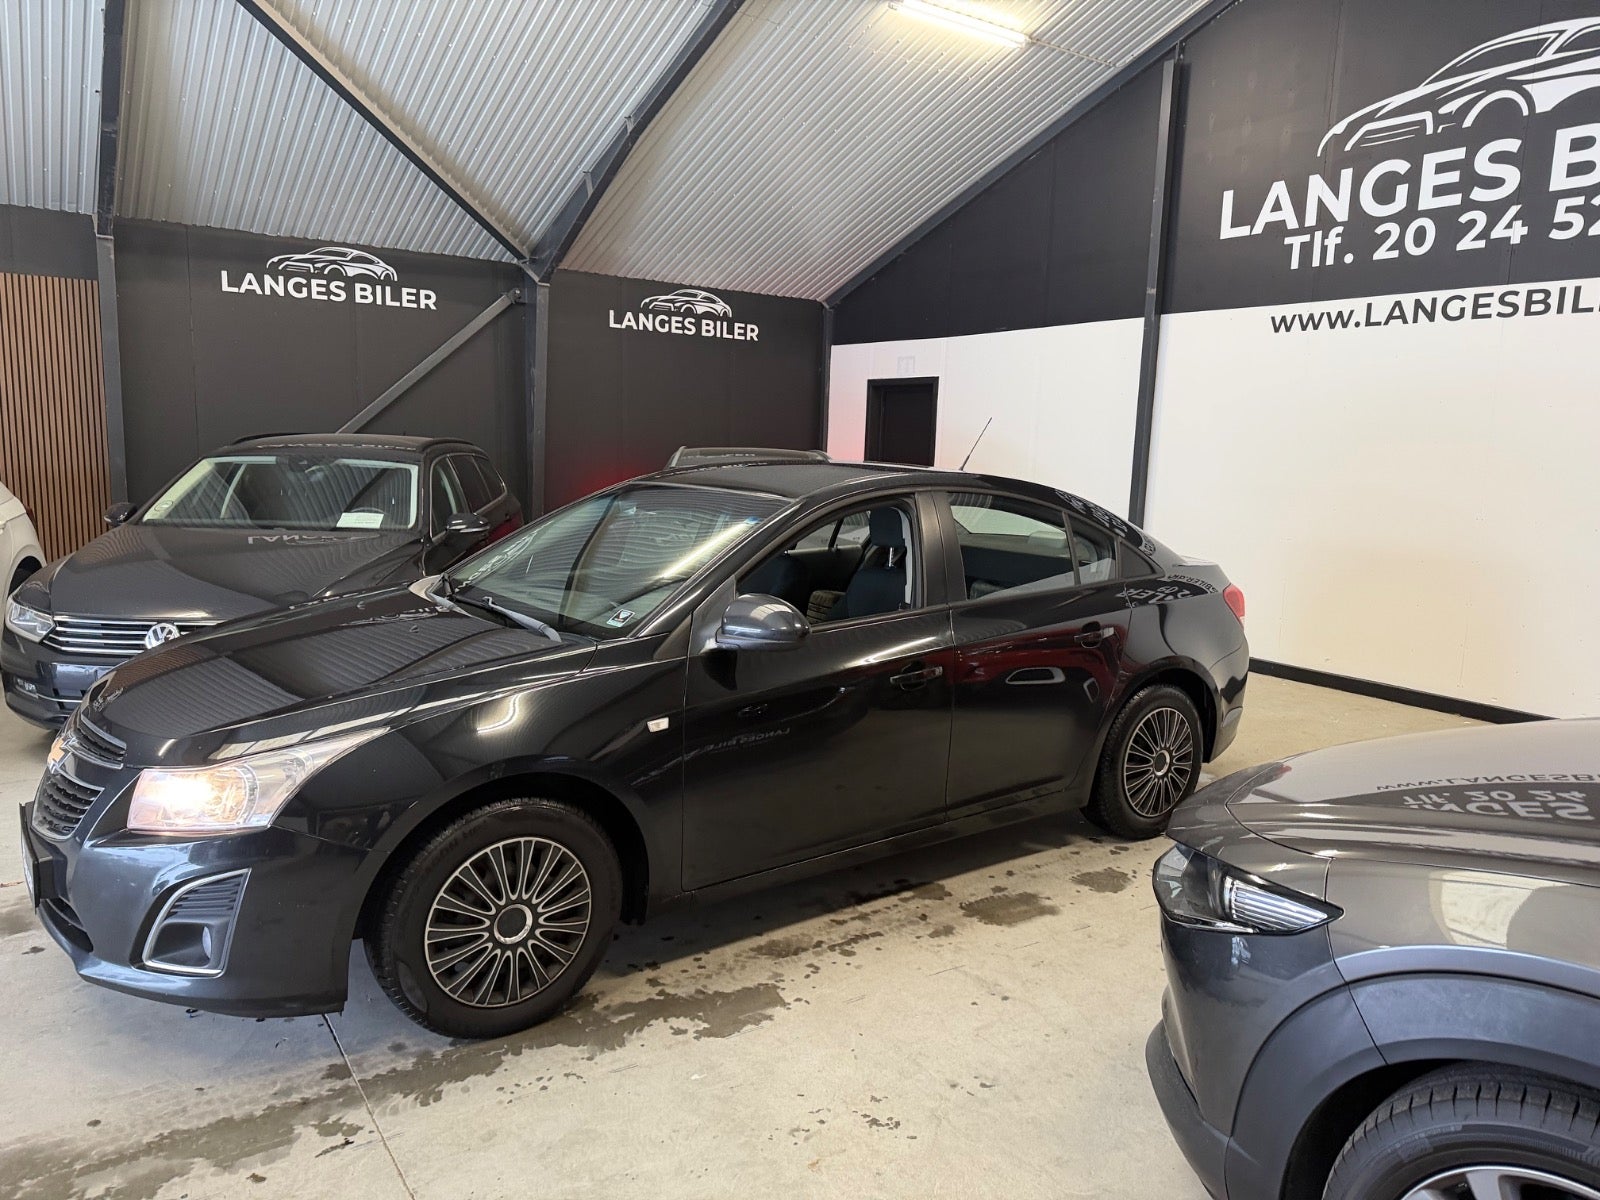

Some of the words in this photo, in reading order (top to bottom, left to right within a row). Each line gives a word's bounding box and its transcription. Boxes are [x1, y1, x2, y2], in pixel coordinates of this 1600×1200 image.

[1219, 138, 1522, 240] LANGES
[1284, 226, 1354, 270] Tlf.
[1372, 217, 1436, 261] 20
[1456, 204, 1528, 251] 24
[220, 270, 347, 302] LANGES
[354, 282, 437, 310] BILER
[1271, 285, 1600, 333] www.LANGESBIL
[609, 309, 697, 335] LANGES
[701, 319, 759, 342] BILER
